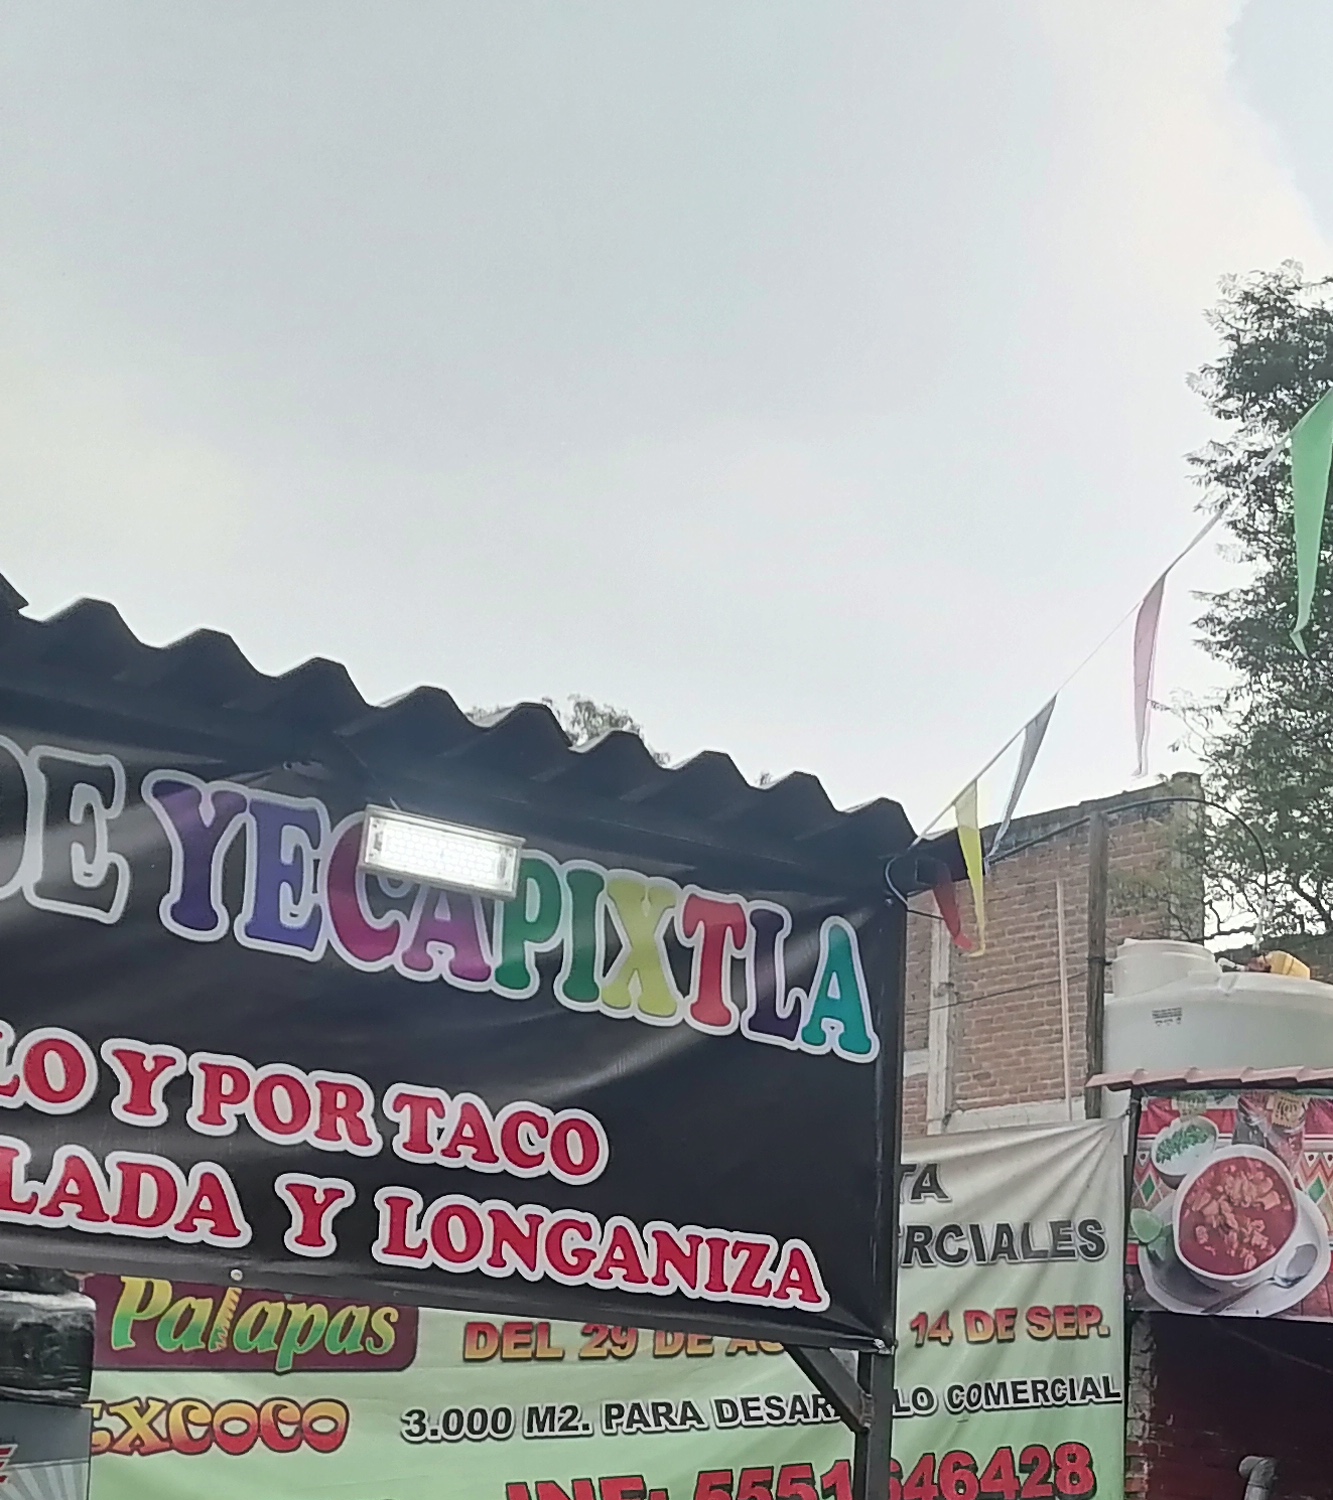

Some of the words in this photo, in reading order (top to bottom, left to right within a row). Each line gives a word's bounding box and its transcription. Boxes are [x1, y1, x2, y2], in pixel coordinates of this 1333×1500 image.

[142, 769, 878, 1062] YECAPIXTLA
[105, 1042, 182, 1123] Y
[189, 1056, 379, 1153] POR
[387, 1087, 605, 1182] TACO
[278, 1177, 351, 1253] Y
[375, 1190, 828, 1308] LONGANIZA
[463, 1321, 564, 1361] DEL
[580, 1323, 638, 1358] 29
[911, 1311, 952, 1347] 14
[965, 1307, 1017, 1343] DE
[1027, 1304, 1110, 1339] SEP.
[402, 1408, 512, 1442] 3.000
[524, 1404, 592, 1438] M2.
[604, 1402, 703, 1432] PARA
[947, 1376, 1122, 1411] COMERCIAL
